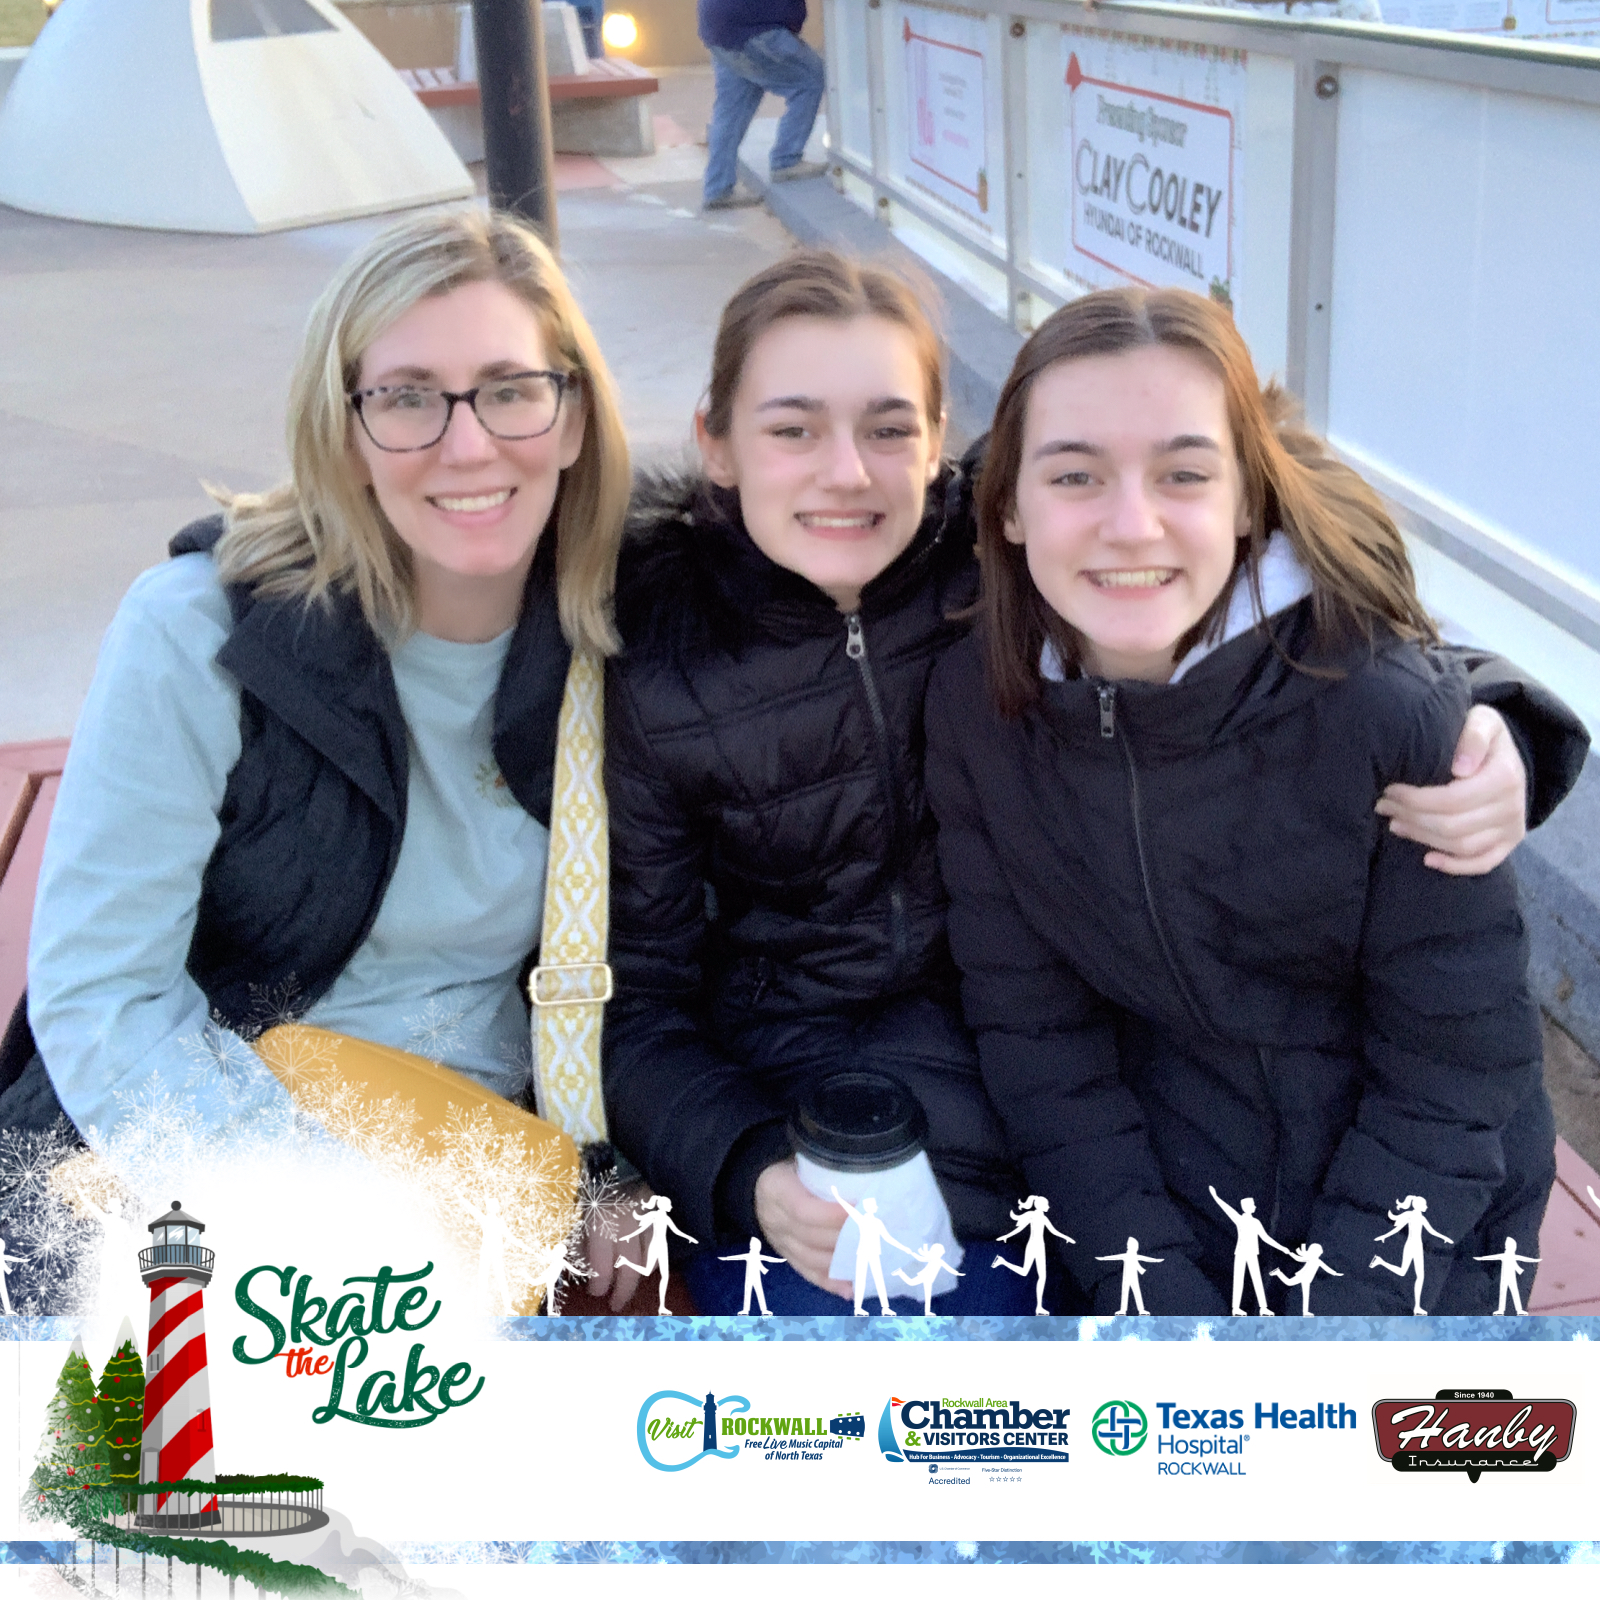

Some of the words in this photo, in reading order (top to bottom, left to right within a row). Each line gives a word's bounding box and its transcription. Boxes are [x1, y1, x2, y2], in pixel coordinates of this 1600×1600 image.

[1075, 138, 1126, 203] CLAY
[1126, 152, 1222, 238] COOLEY
[1083, 201, 1125, 242] HYUNDAI
[1127, 221, 1143, 247] OF
[1145, 228, 1204, 279] ROCKWALL
